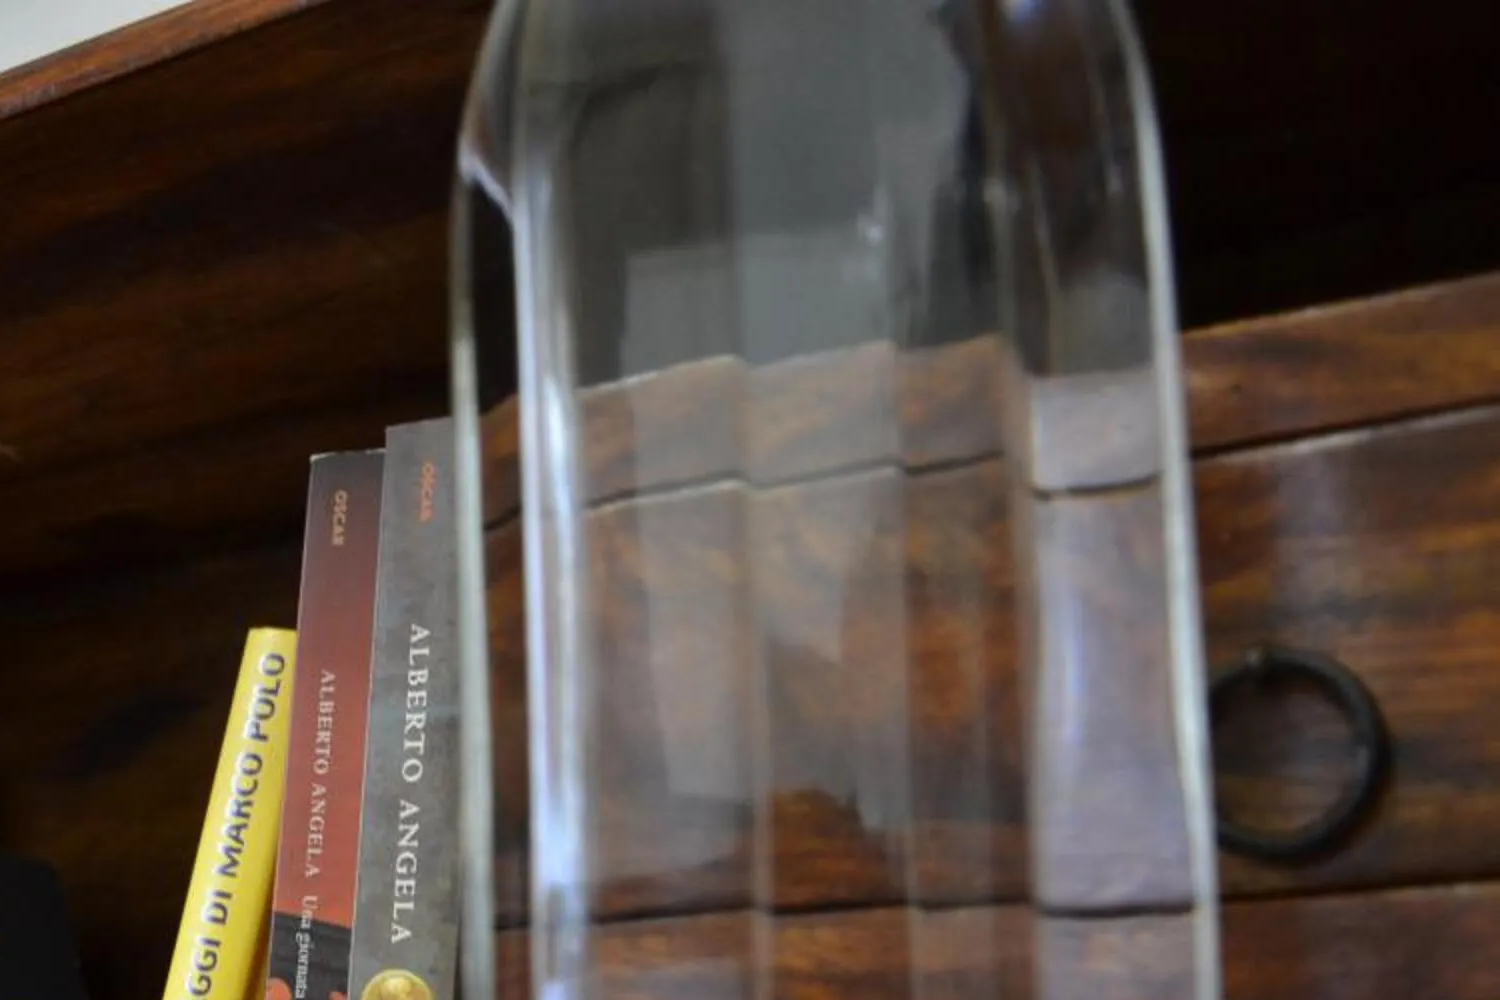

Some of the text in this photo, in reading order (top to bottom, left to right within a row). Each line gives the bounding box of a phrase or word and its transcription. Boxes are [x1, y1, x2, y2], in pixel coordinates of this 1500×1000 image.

[331, 488, 349, 547] OSCAR
[419, 459, 437, 523] OSCAR
[244, 652, 285, 743] POLO
[304, 668, 337, 879] ALBERTO ANGELA
[391, 623, 431, 944] ALBERTO ANGELA
[215, 751, 264, 879] MARCO
[201, 888, 233, 926] DI
[299, 895, 318, 929] Una
[294, 931, 314, 999] giornata
